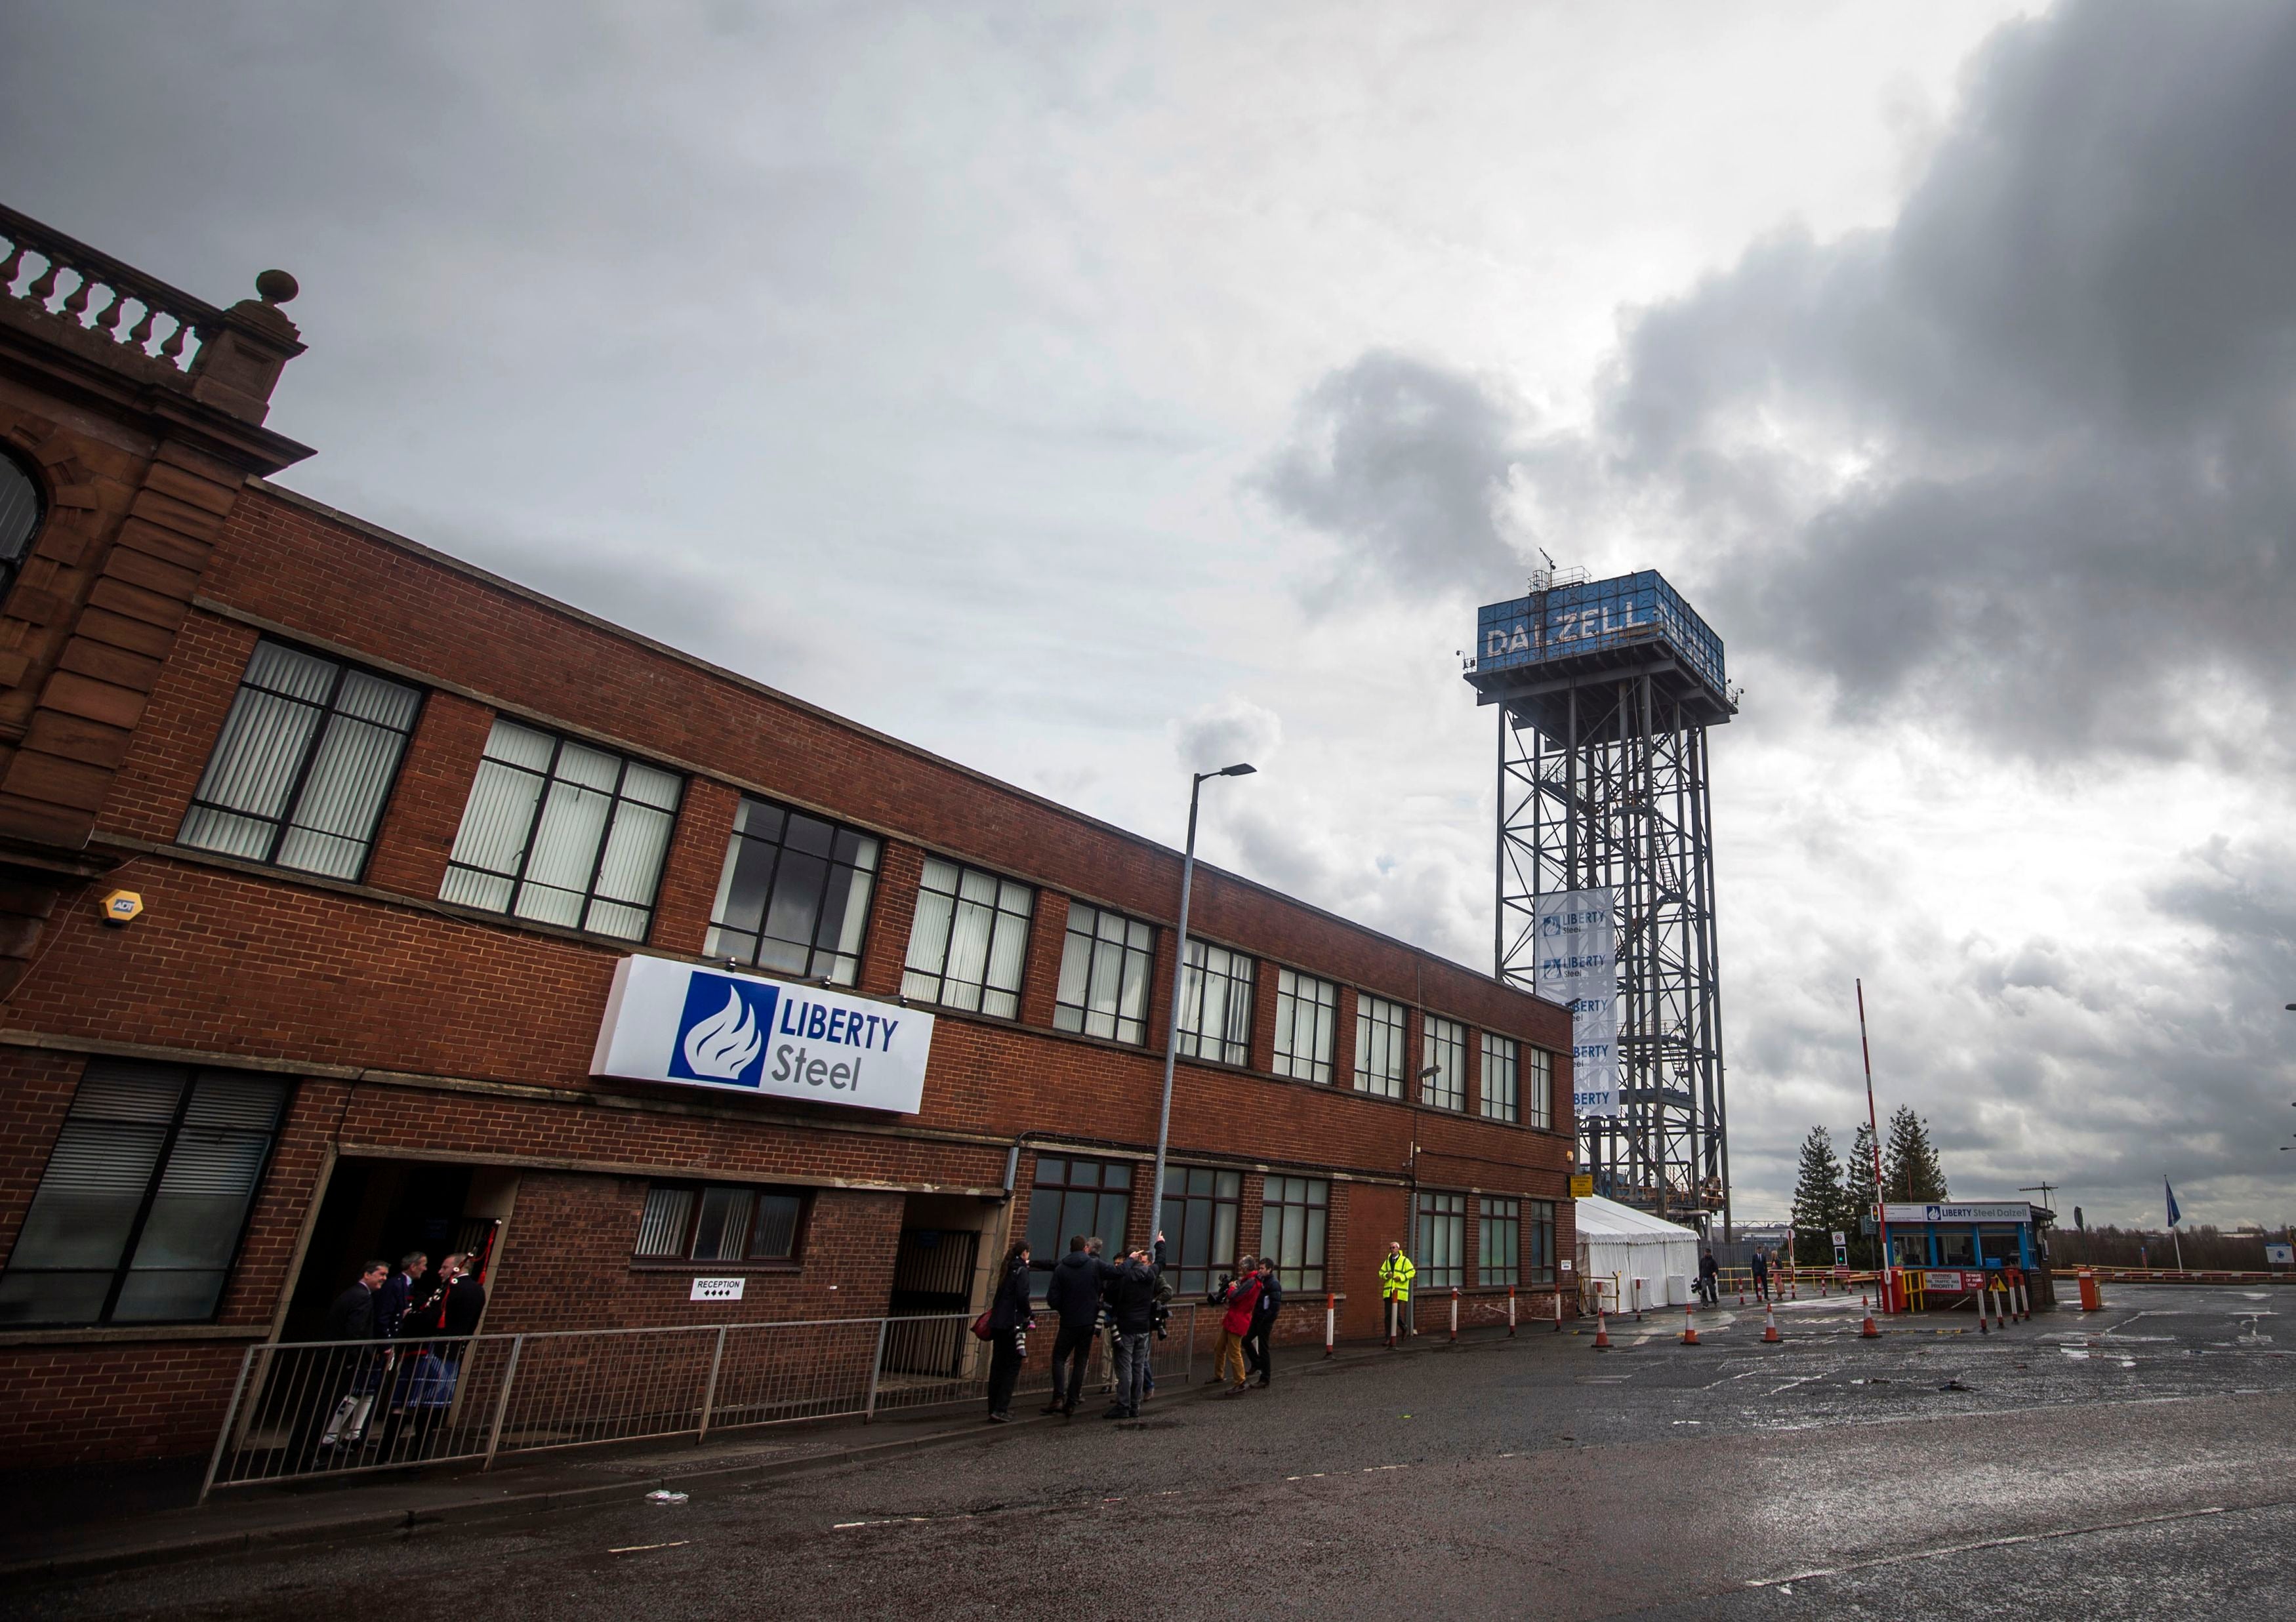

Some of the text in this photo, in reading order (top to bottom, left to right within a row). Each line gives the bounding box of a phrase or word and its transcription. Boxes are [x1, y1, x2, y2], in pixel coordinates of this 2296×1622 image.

[1486, 601, 1647, 657] DALZELL
[114, 901, 134, 910] ADT
[1563, 910, 1605, 925] LIBERTY
[1563, 925, 1581, 934] Steel
[1563, 954, 1606, 969] LIBERTY
[1564, 969, 1582, 978] Steel
[1568, 999, 1608, 1012] BERTY
[780, 999, 899, 1052] LIBERTY
[1574, 1045, 1609, 1057] BERTY
[771, 1044, 861, 1091] Steel
[1574, 1092, 1609, 1105] BERTY
